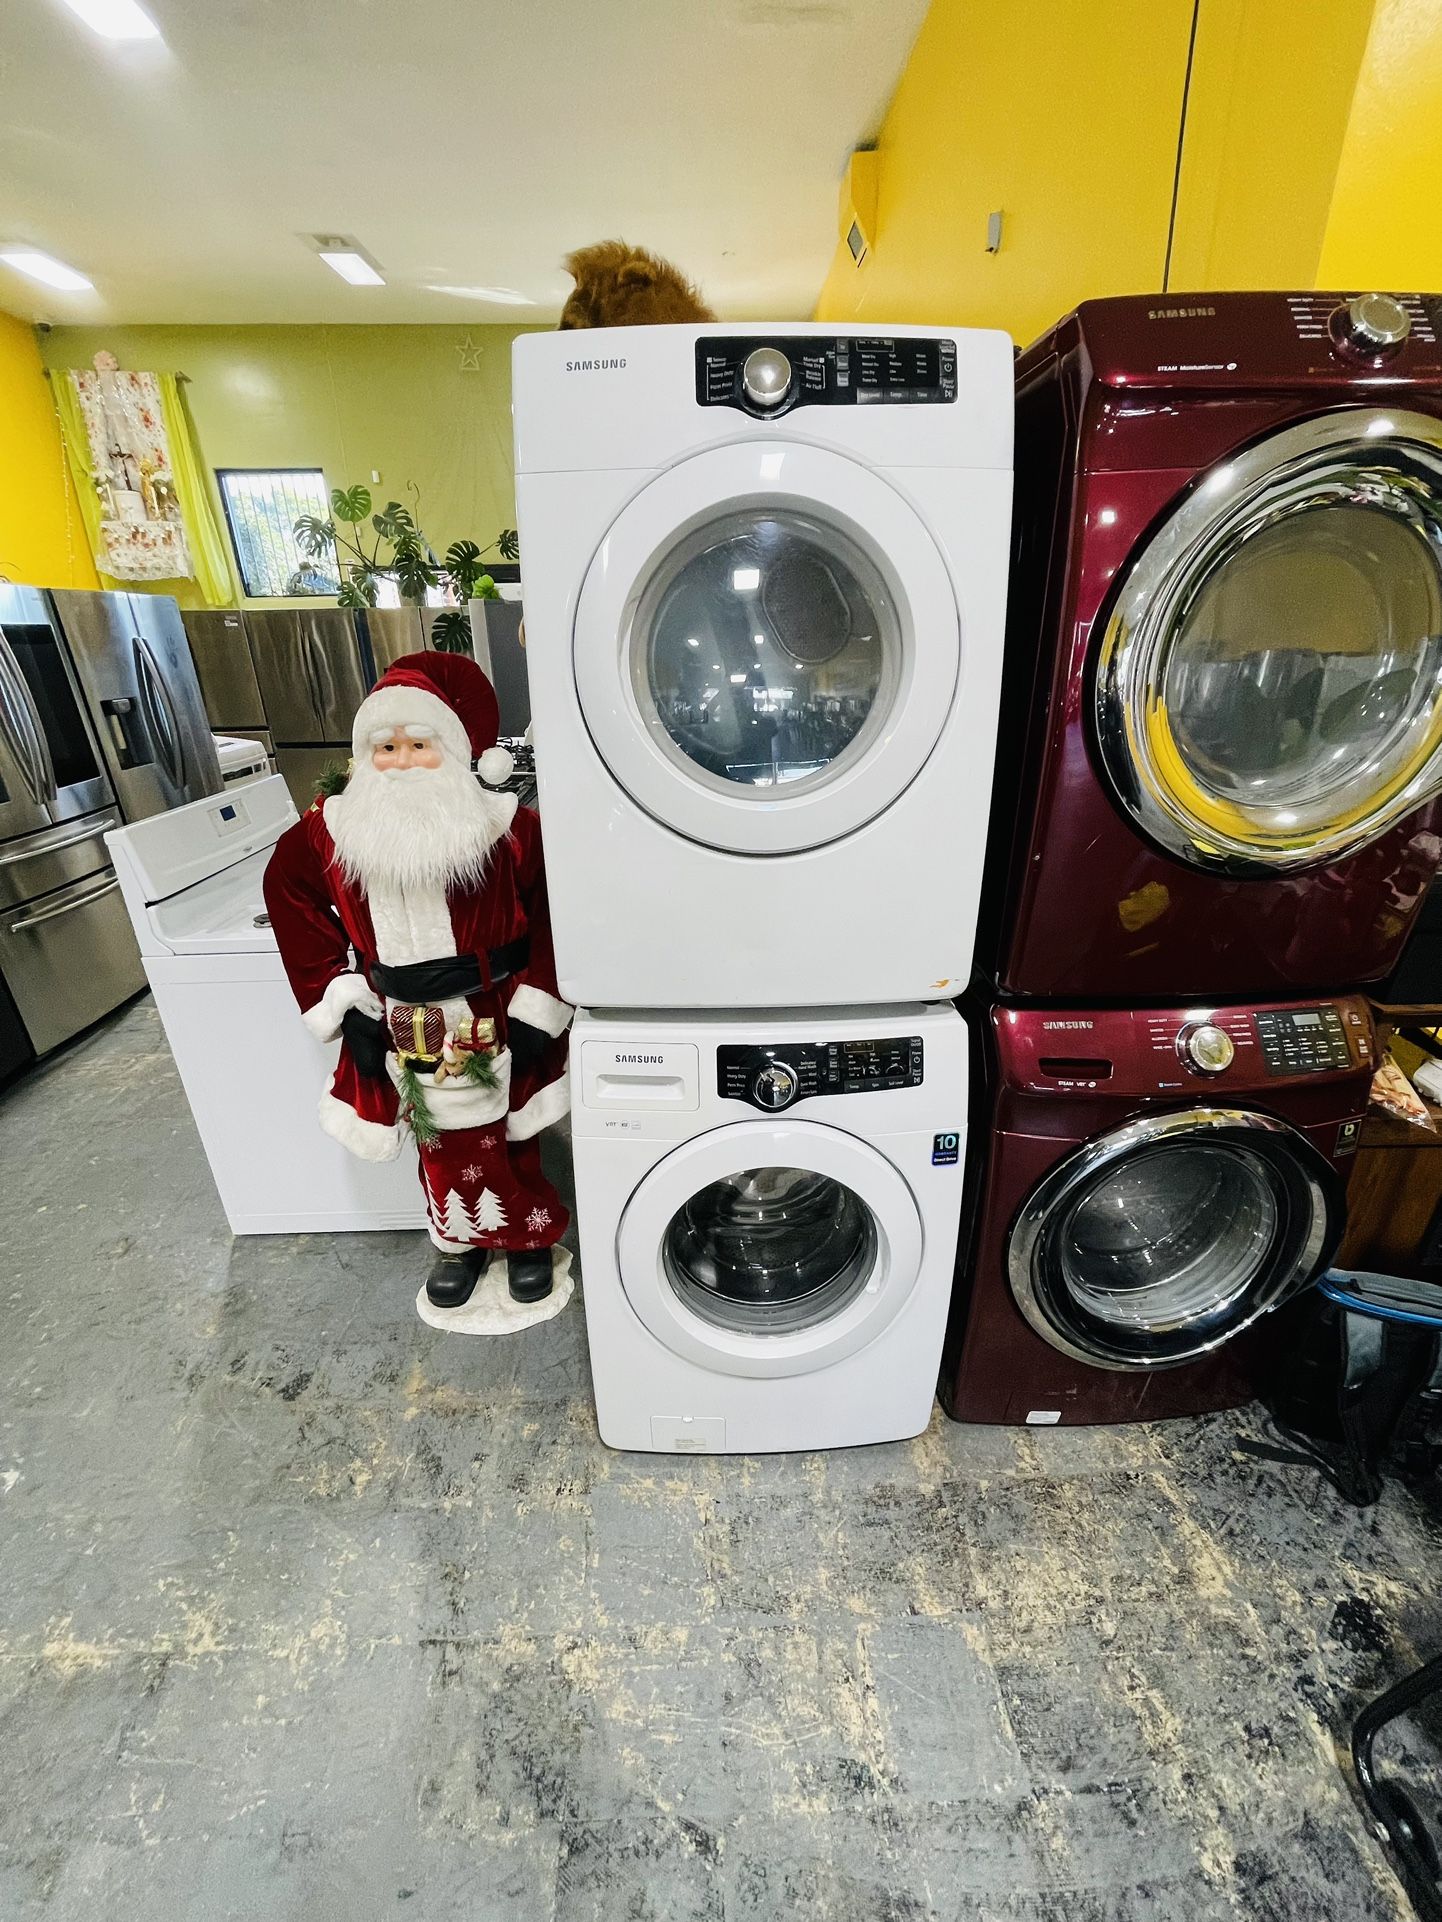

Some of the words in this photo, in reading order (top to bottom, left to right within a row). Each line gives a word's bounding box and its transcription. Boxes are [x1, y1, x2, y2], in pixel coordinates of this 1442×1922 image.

[1148, 307, 1216, 320] SAMSUNG
[566, 358, 627, 372] SAMSUNG
[1042, 1020, 1094, 1030] SAMSUNG
[615, 1054, 664, 1064] SAMSUNG
[937, 1135, 957, 1150] 10
